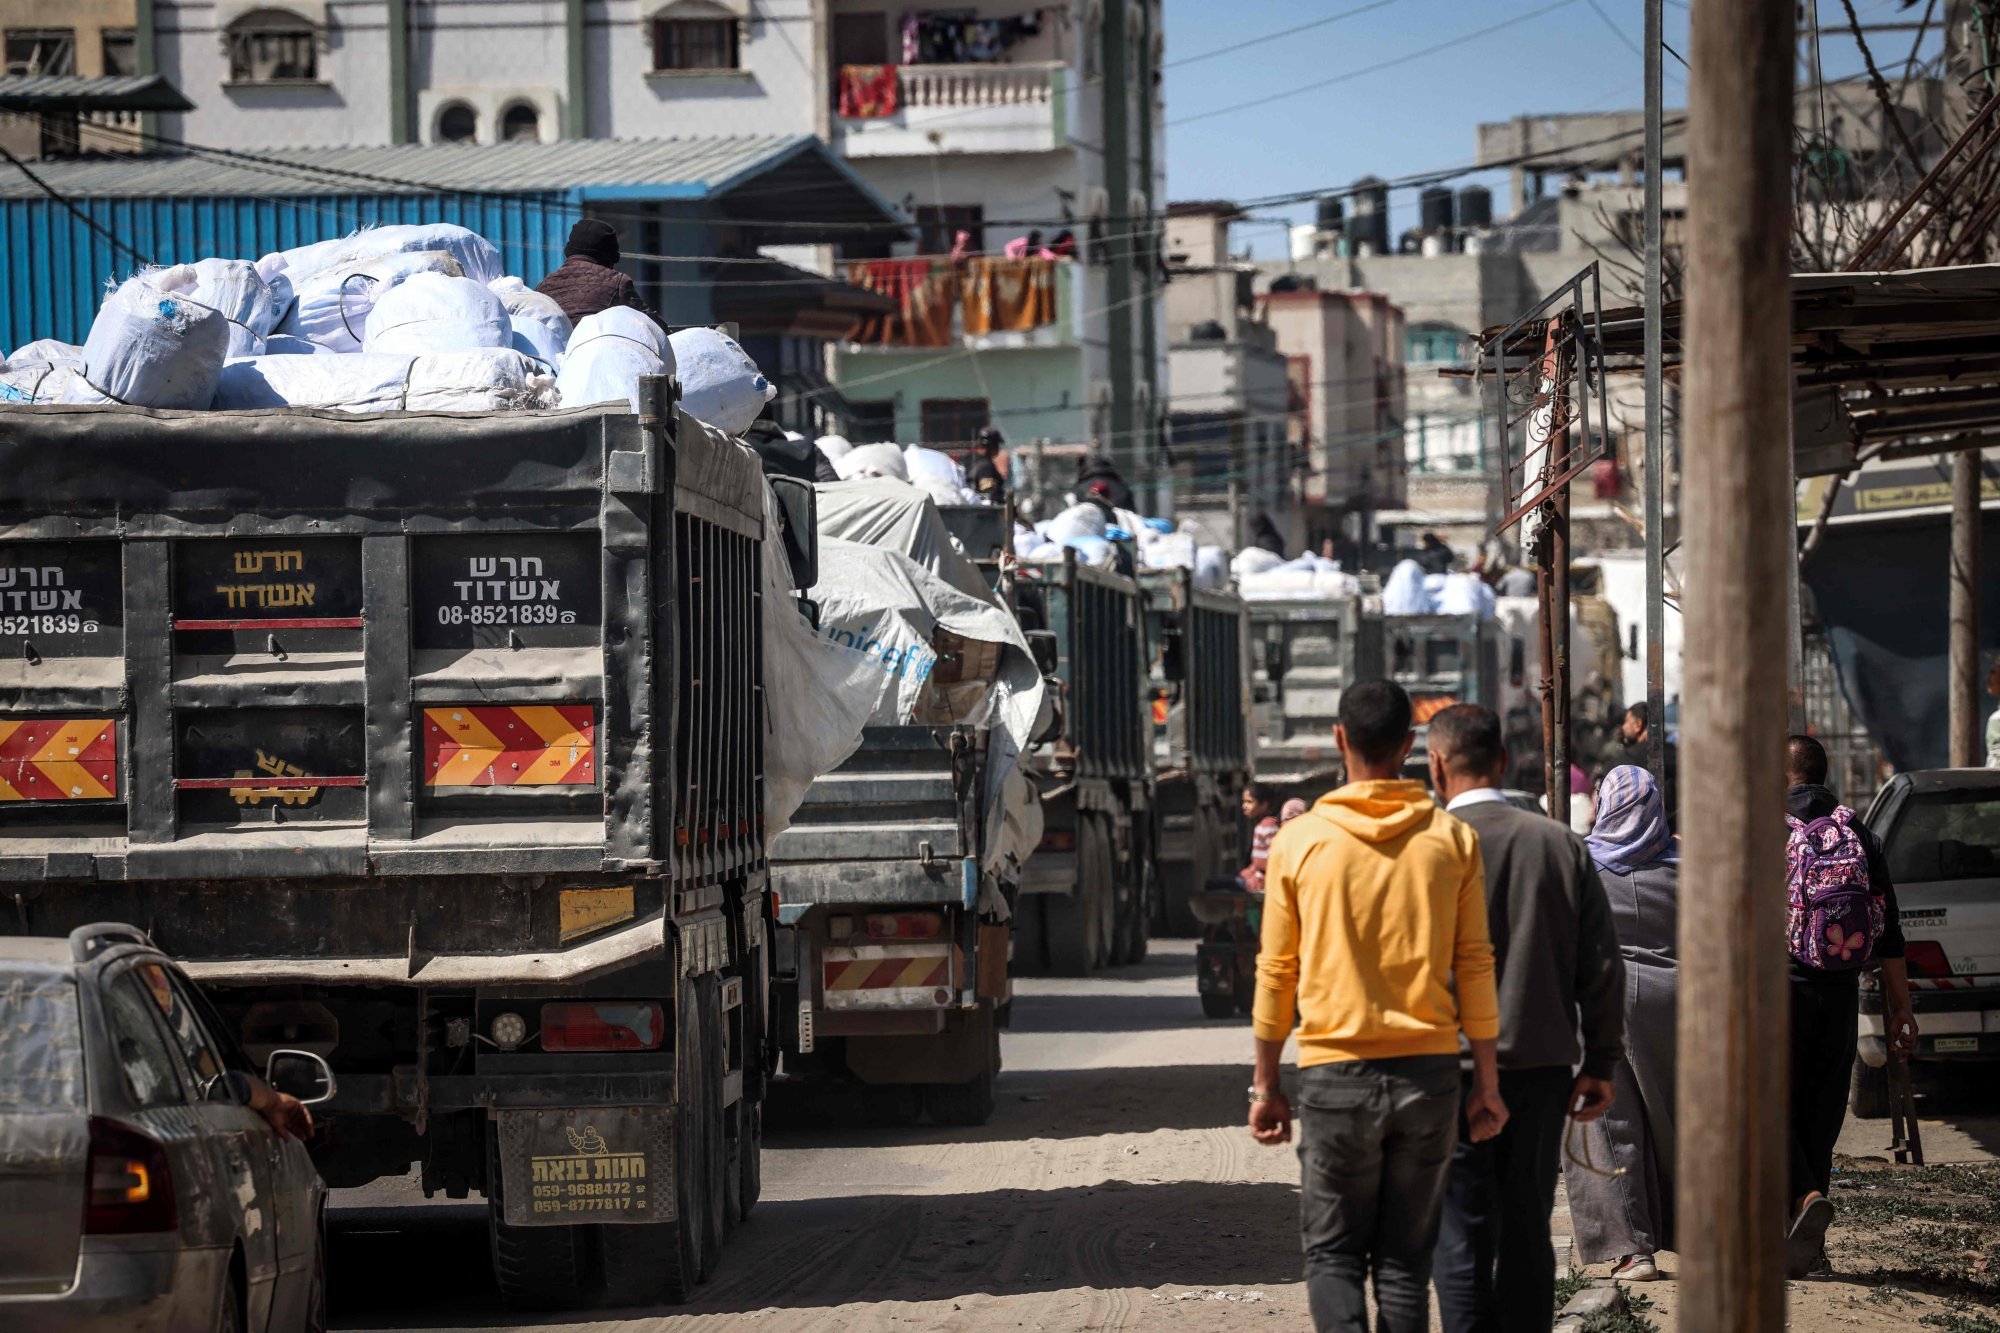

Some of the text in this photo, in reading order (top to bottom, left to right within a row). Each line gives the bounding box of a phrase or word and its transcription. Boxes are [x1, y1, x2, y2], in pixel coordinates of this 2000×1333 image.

[234, 550, 302, 573] חרש
[469, 557, 543, 577] חרש
[0, 566, 64, 587] חרש
[216, 583, 316, 608] אשדוד
[454, 580, 560, 601] אשדוד
[0, 614, 80, 635] 521839
[438, 604, 558, 625] 08-8521839
[458, 723, 470, 731] 3M
[1952, 962, 1978, 975] Wifi
[594, 1158, 646, 1180] חנות
[533, 1183, 631, 1197] 059-9688472
[534, 1198, 631, 1213] 059-8777817
